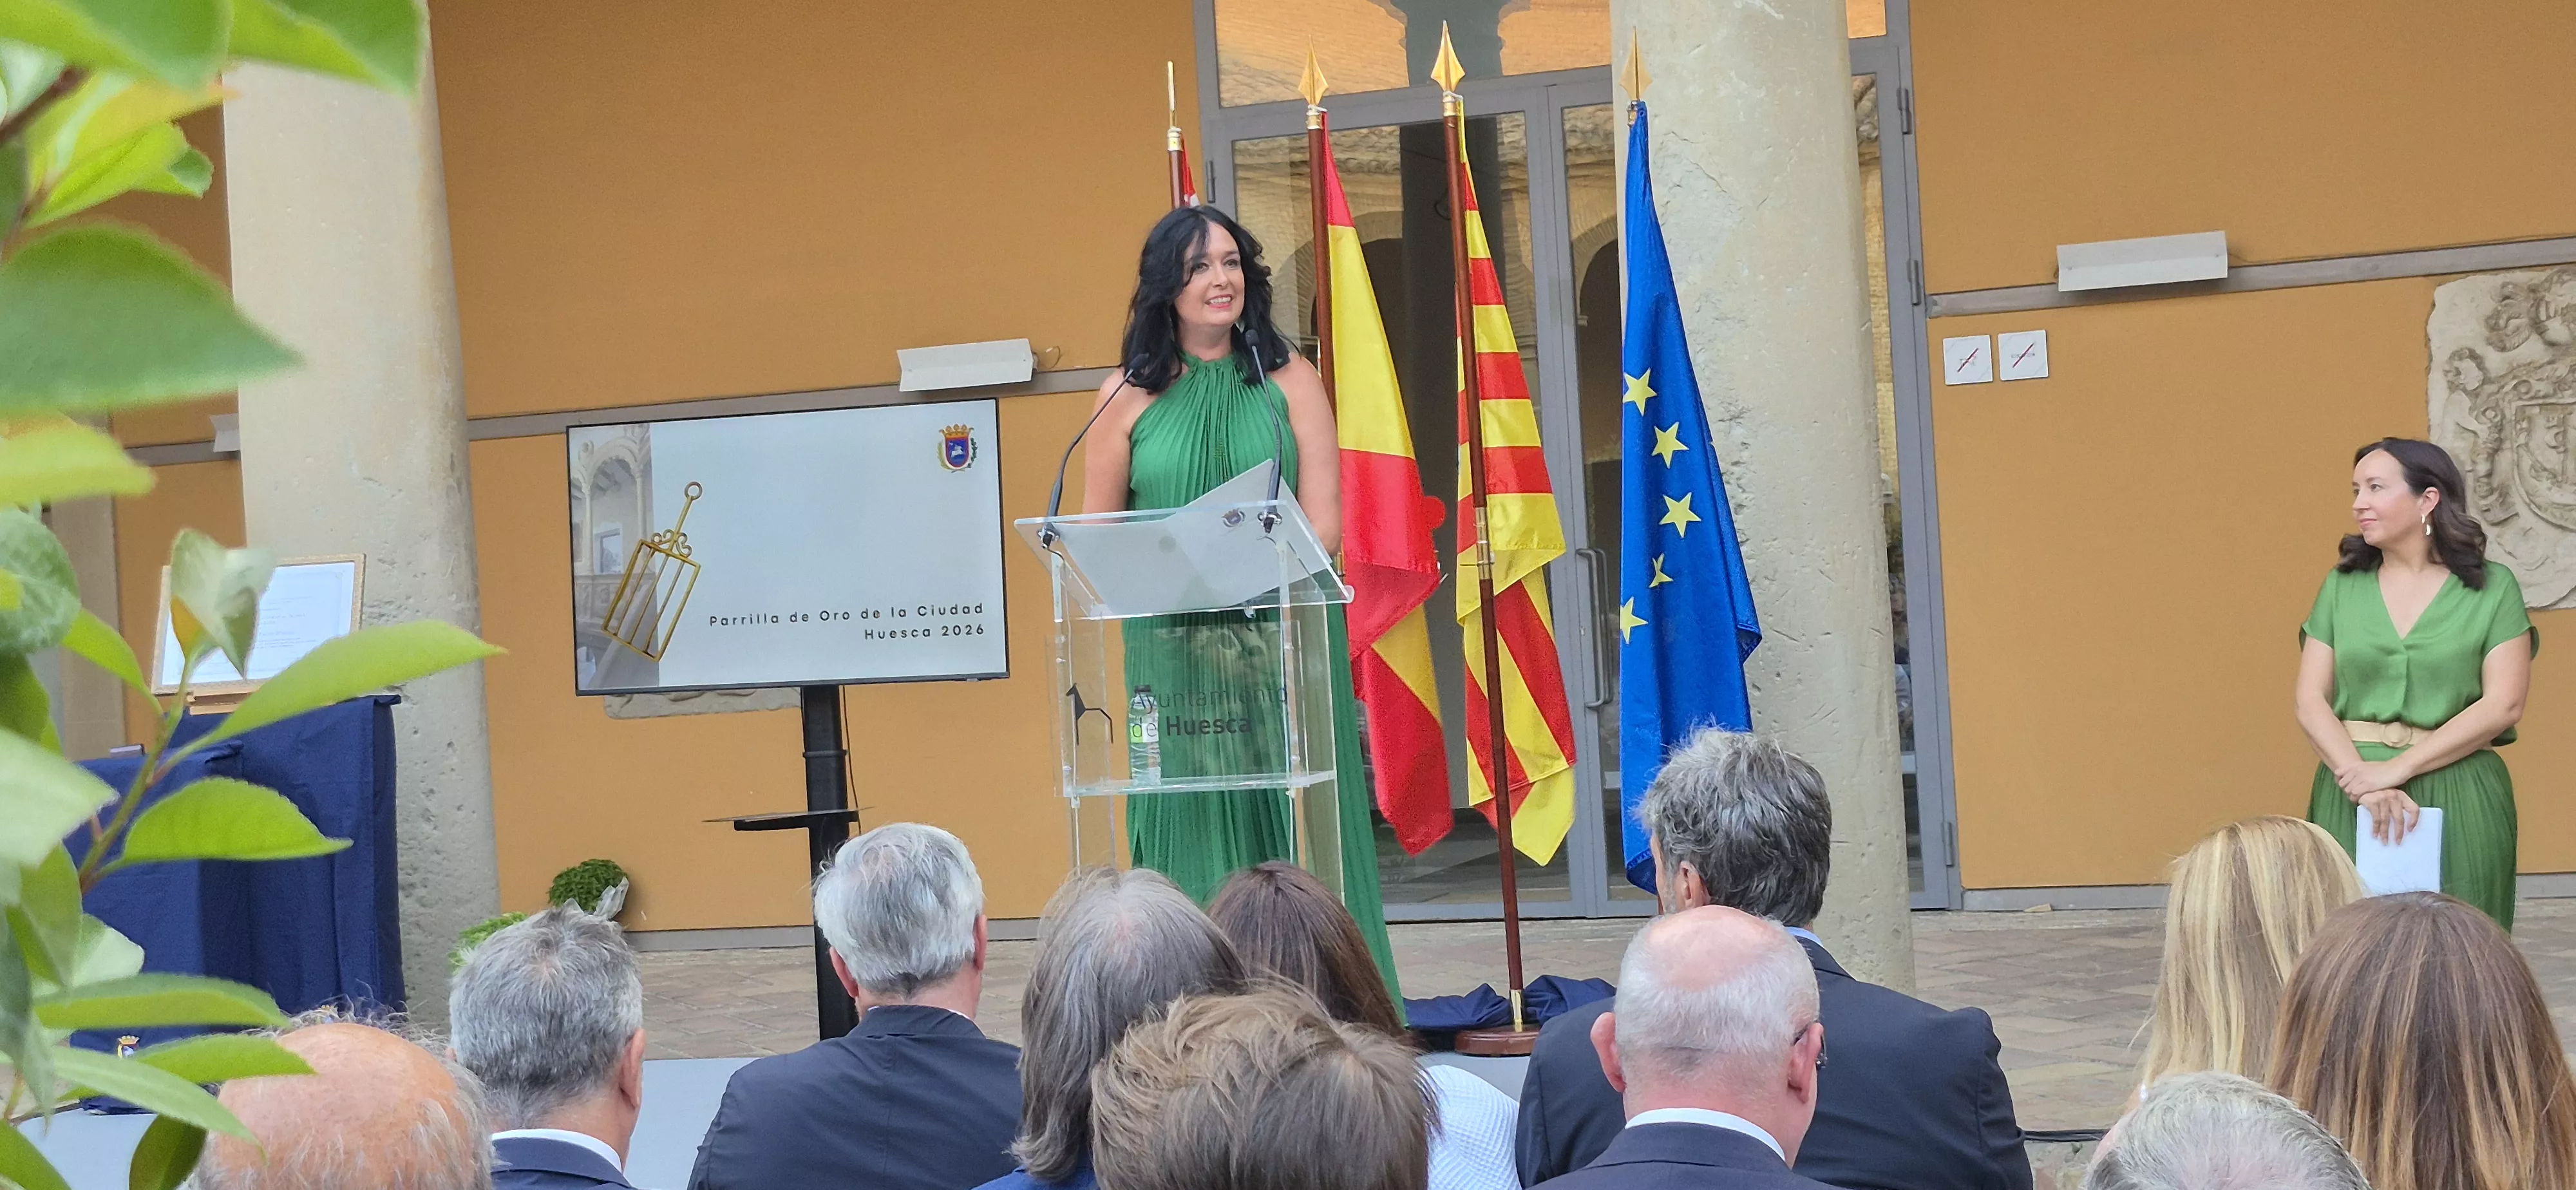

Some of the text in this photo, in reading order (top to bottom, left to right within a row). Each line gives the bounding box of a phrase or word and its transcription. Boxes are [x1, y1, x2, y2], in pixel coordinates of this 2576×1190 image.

[710, 603, 983, 627] Parrilla de Oro de la Ciudad
[864, 624, 984, 640] Huesca 2026
[1132, 687, 1287, 715] Ayuntamiento
[1132, 715, 1253, 737] de Huesca
